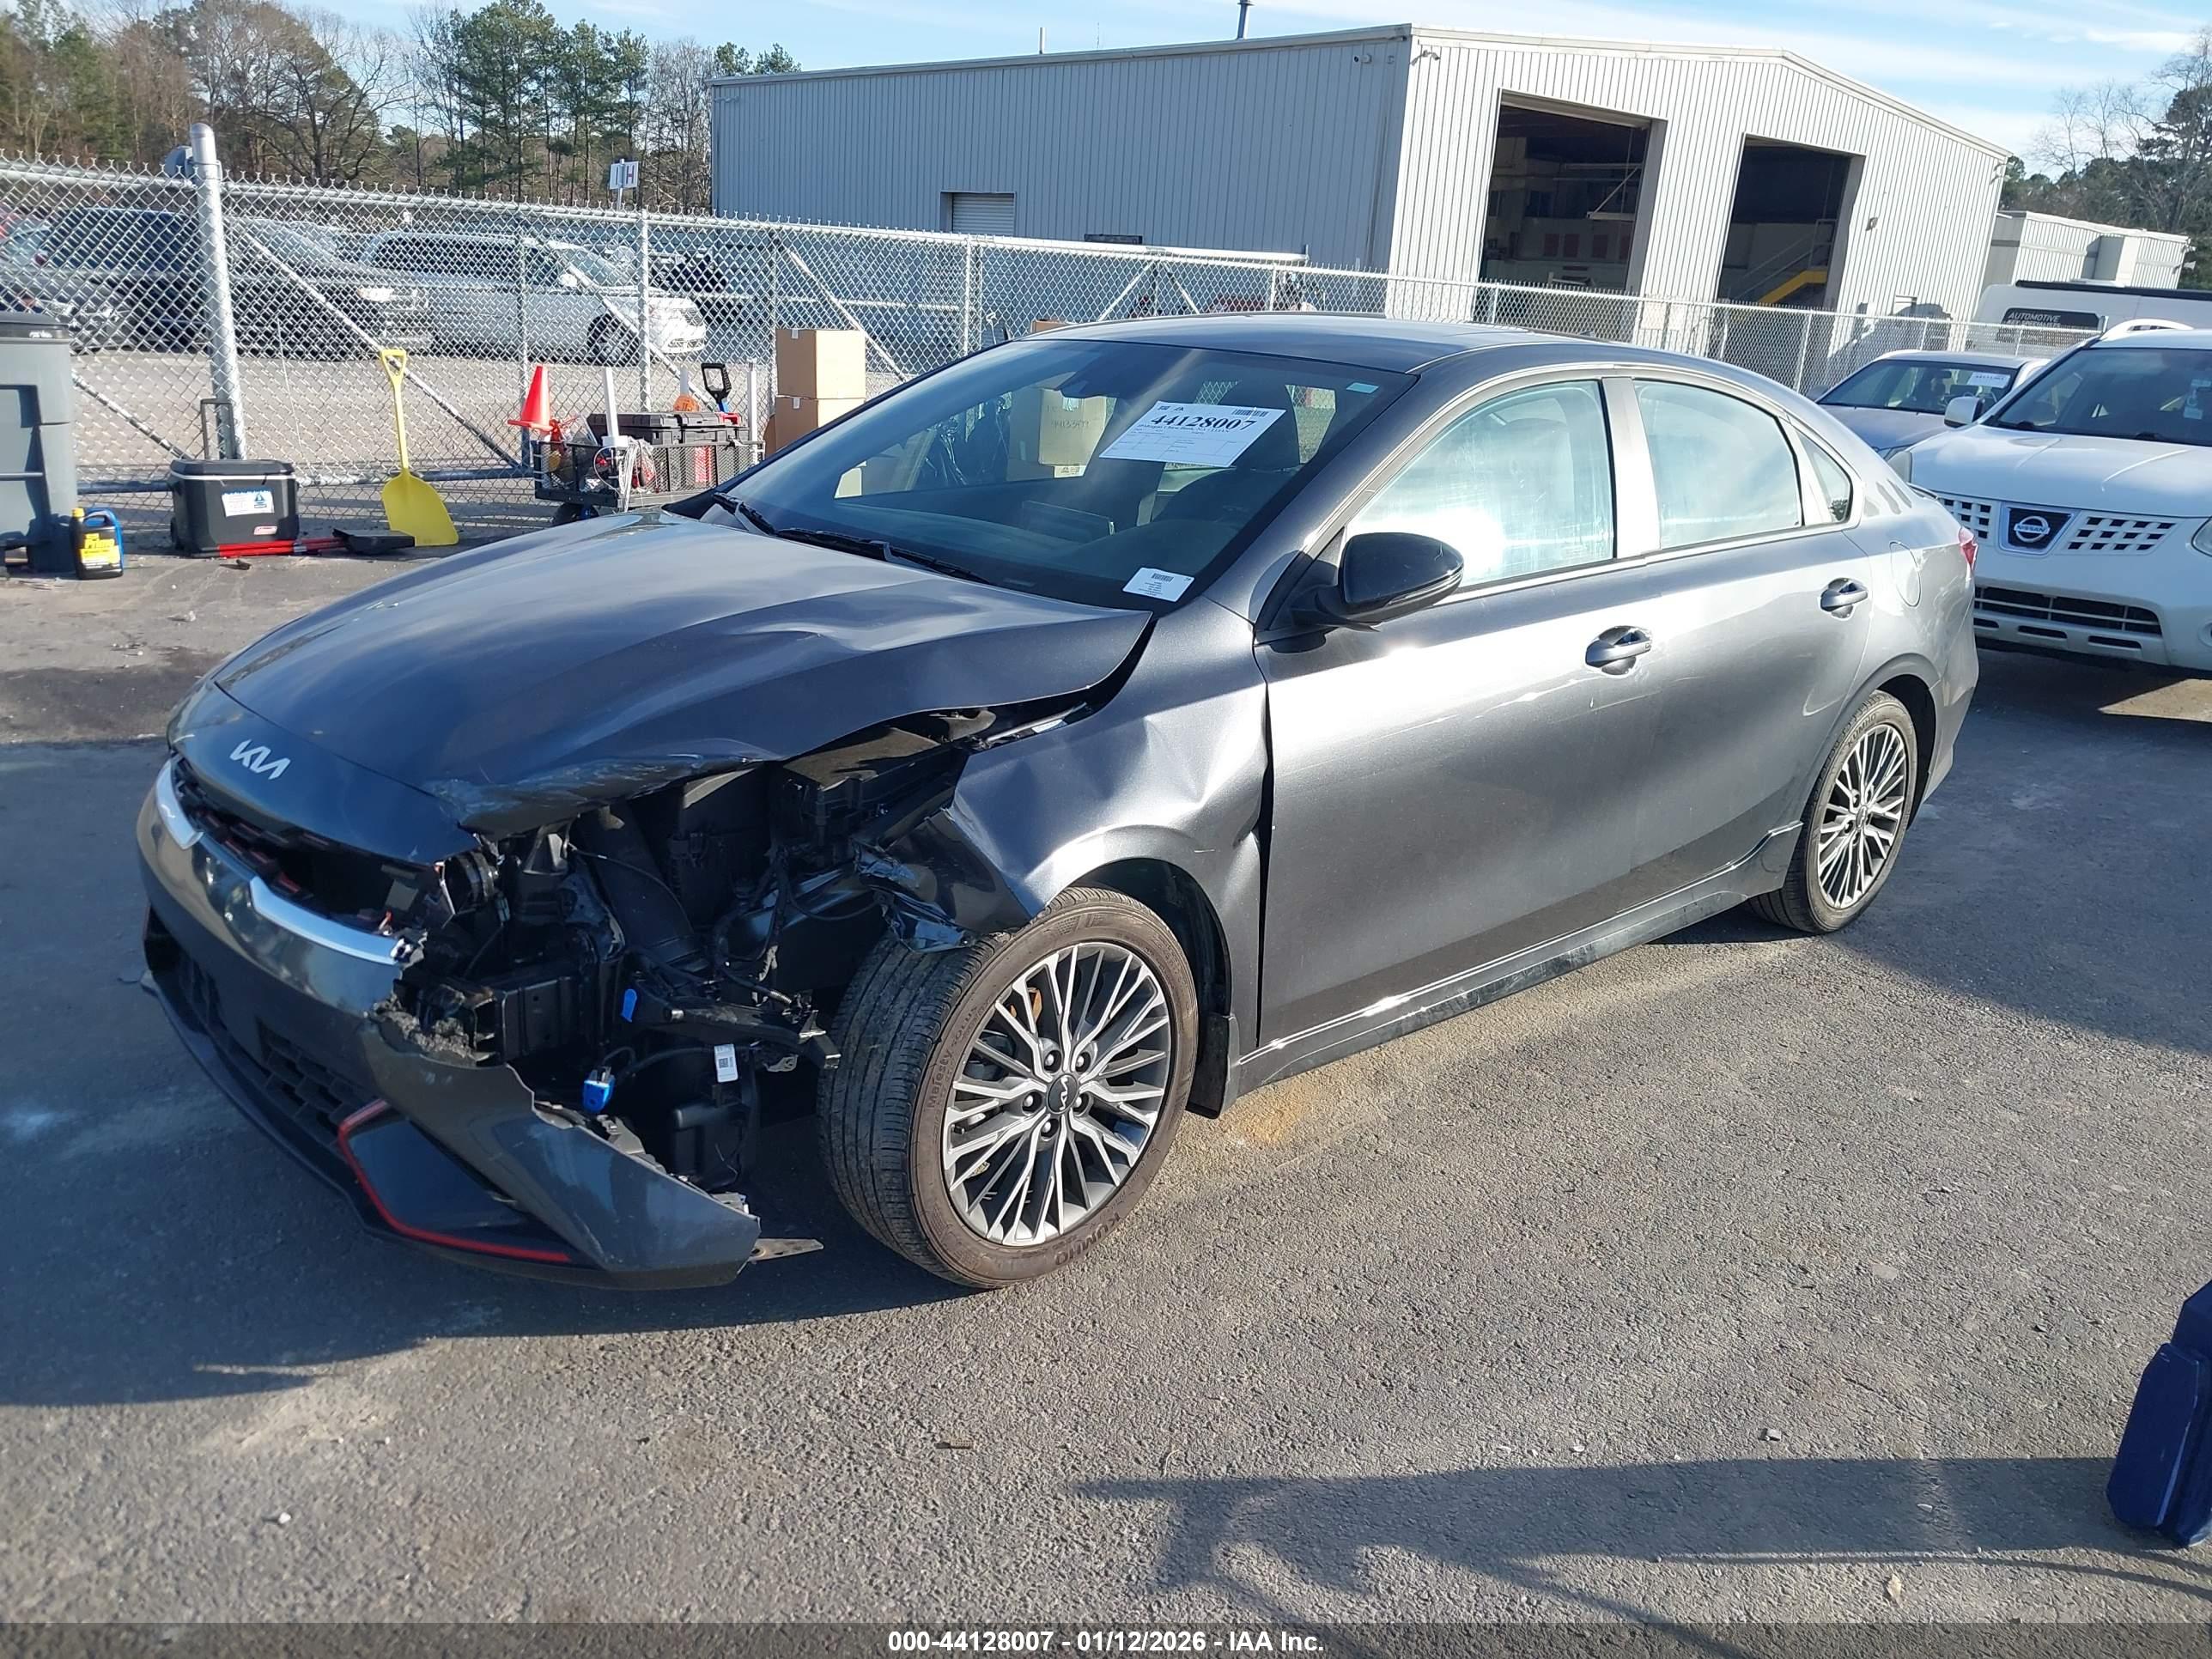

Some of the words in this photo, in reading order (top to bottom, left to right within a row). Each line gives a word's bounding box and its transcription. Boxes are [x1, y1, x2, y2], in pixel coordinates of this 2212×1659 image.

[2008, 312, 2061, 322] AUTOMOTIVE
[1151, 414, 1257, 431] 44128007
[1846, 713, 1877, 748] KUMHO
[229, 738, 291, 781] KIA
[927, 1048, 953, 1109] Majesty
[1054, 1212, 1121, 1266] KUMHO
